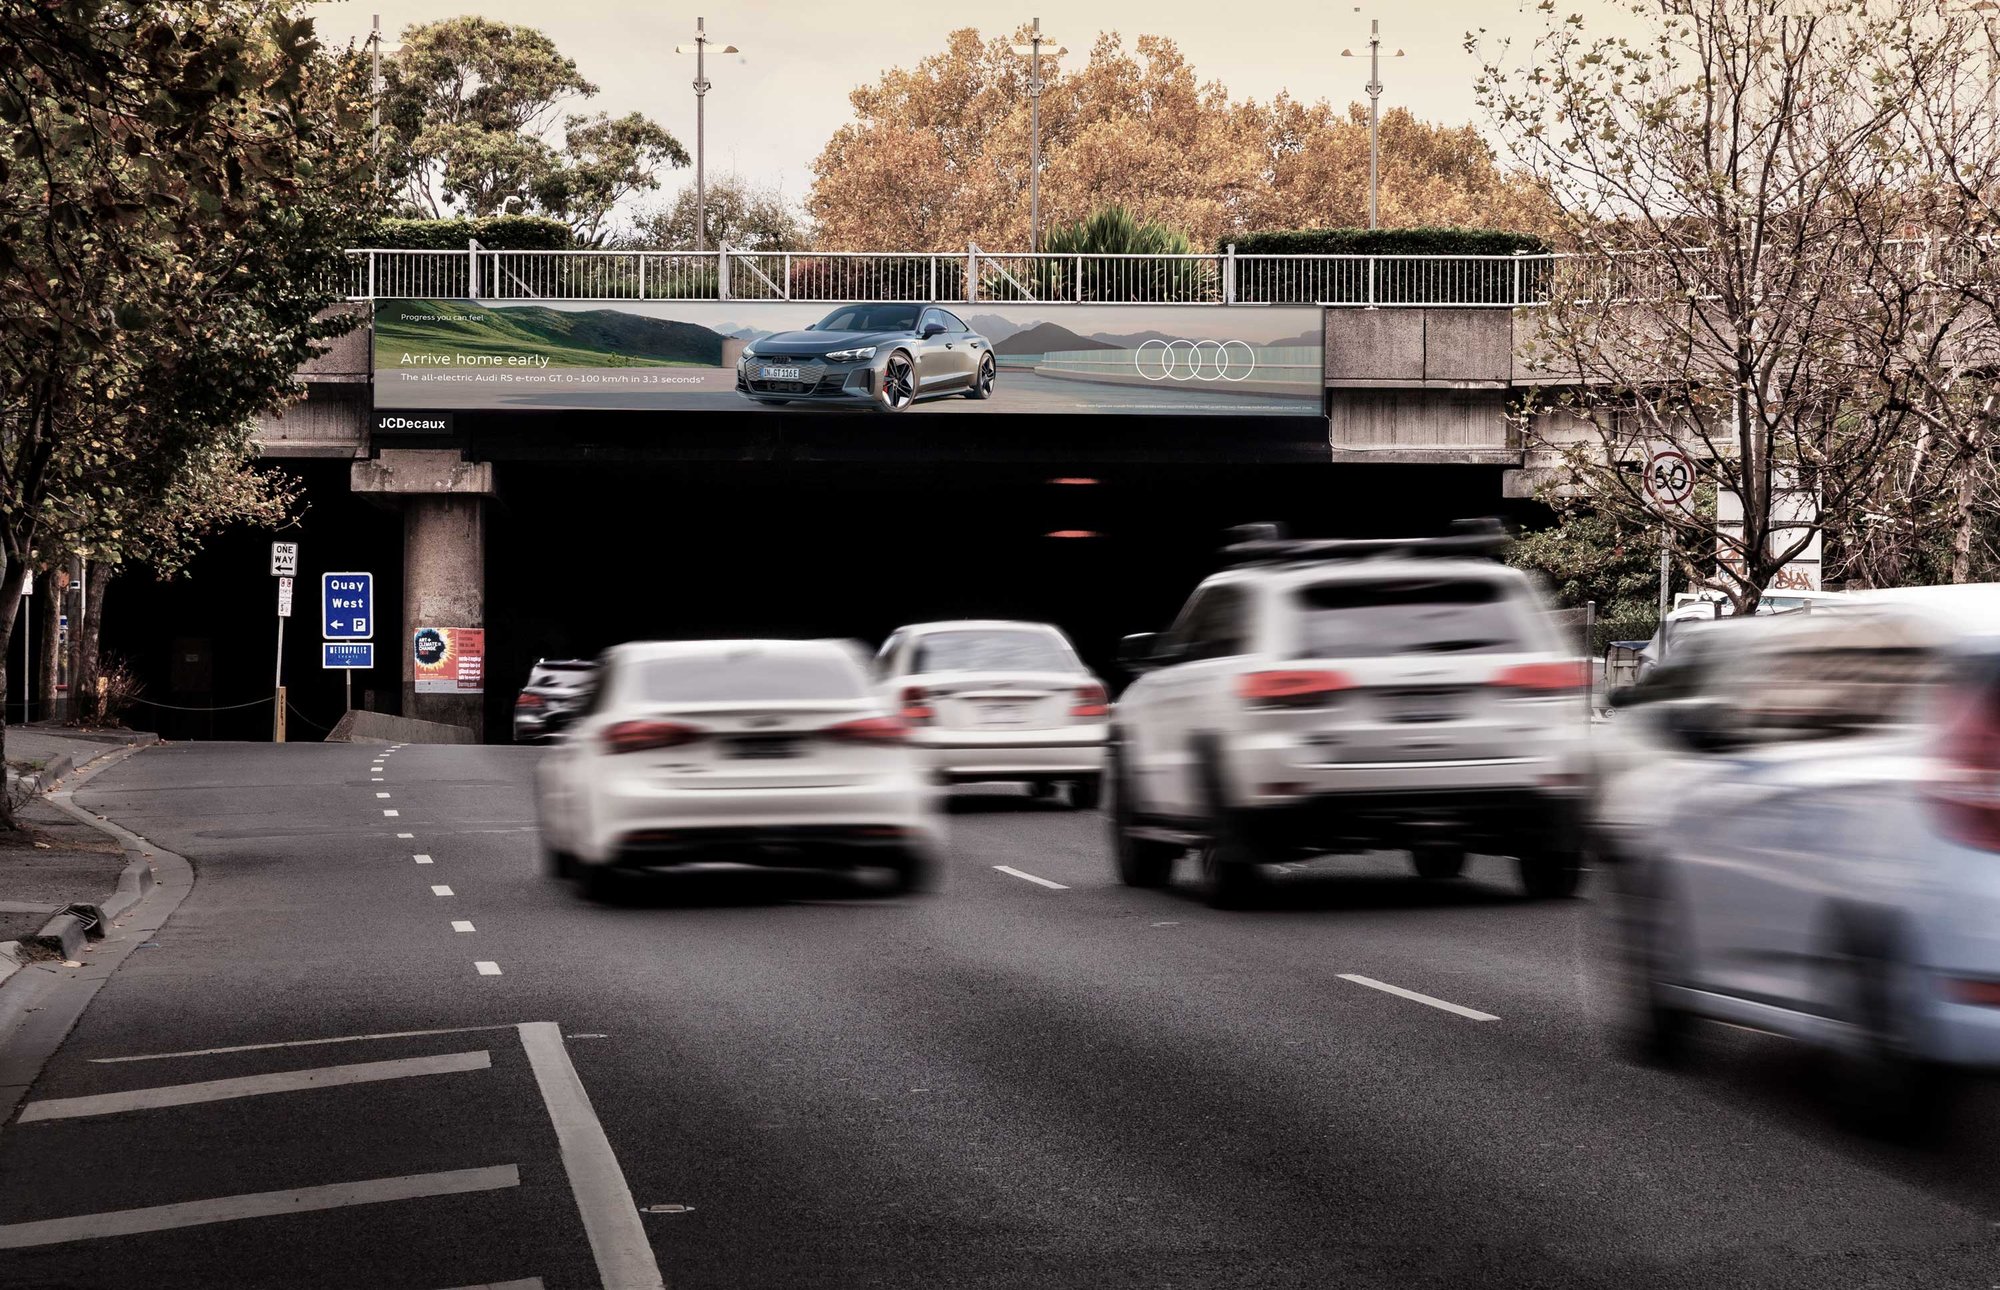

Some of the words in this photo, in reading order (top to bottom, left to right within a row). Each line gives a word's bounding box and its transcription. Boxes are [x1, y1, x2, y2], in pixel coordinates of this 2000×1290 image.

[401, 313, 436, 321] Progress
[400, 352, 451, 365] Arrive
[456, 353, 503, 365] home
[508, 353, 550, 368] early
[401, 373, 419, 381] The
[421, 374, 473, 382] all-electric
[475, 374, 498, 382] Audi
[500, 374, 513, 382] RS
[549, 374, 564, 383] GT.
[602, 375, 628, 383] km/h
[631, 375, 640, 383] in
[642, 375, 658, 383] 3.3
[379, 417, 446, 429] JCDecaux
[1655, 464, 1687, 490] 60
[276, 545, 294, 554] ONE
[275, 555, 294, 564] WAY
[331, 580, 364, 592] Quay
[332, 598, 364, 608] West
[355, 620, 364, 629] P
[329, 646, 367, 654] METROPOLIS
